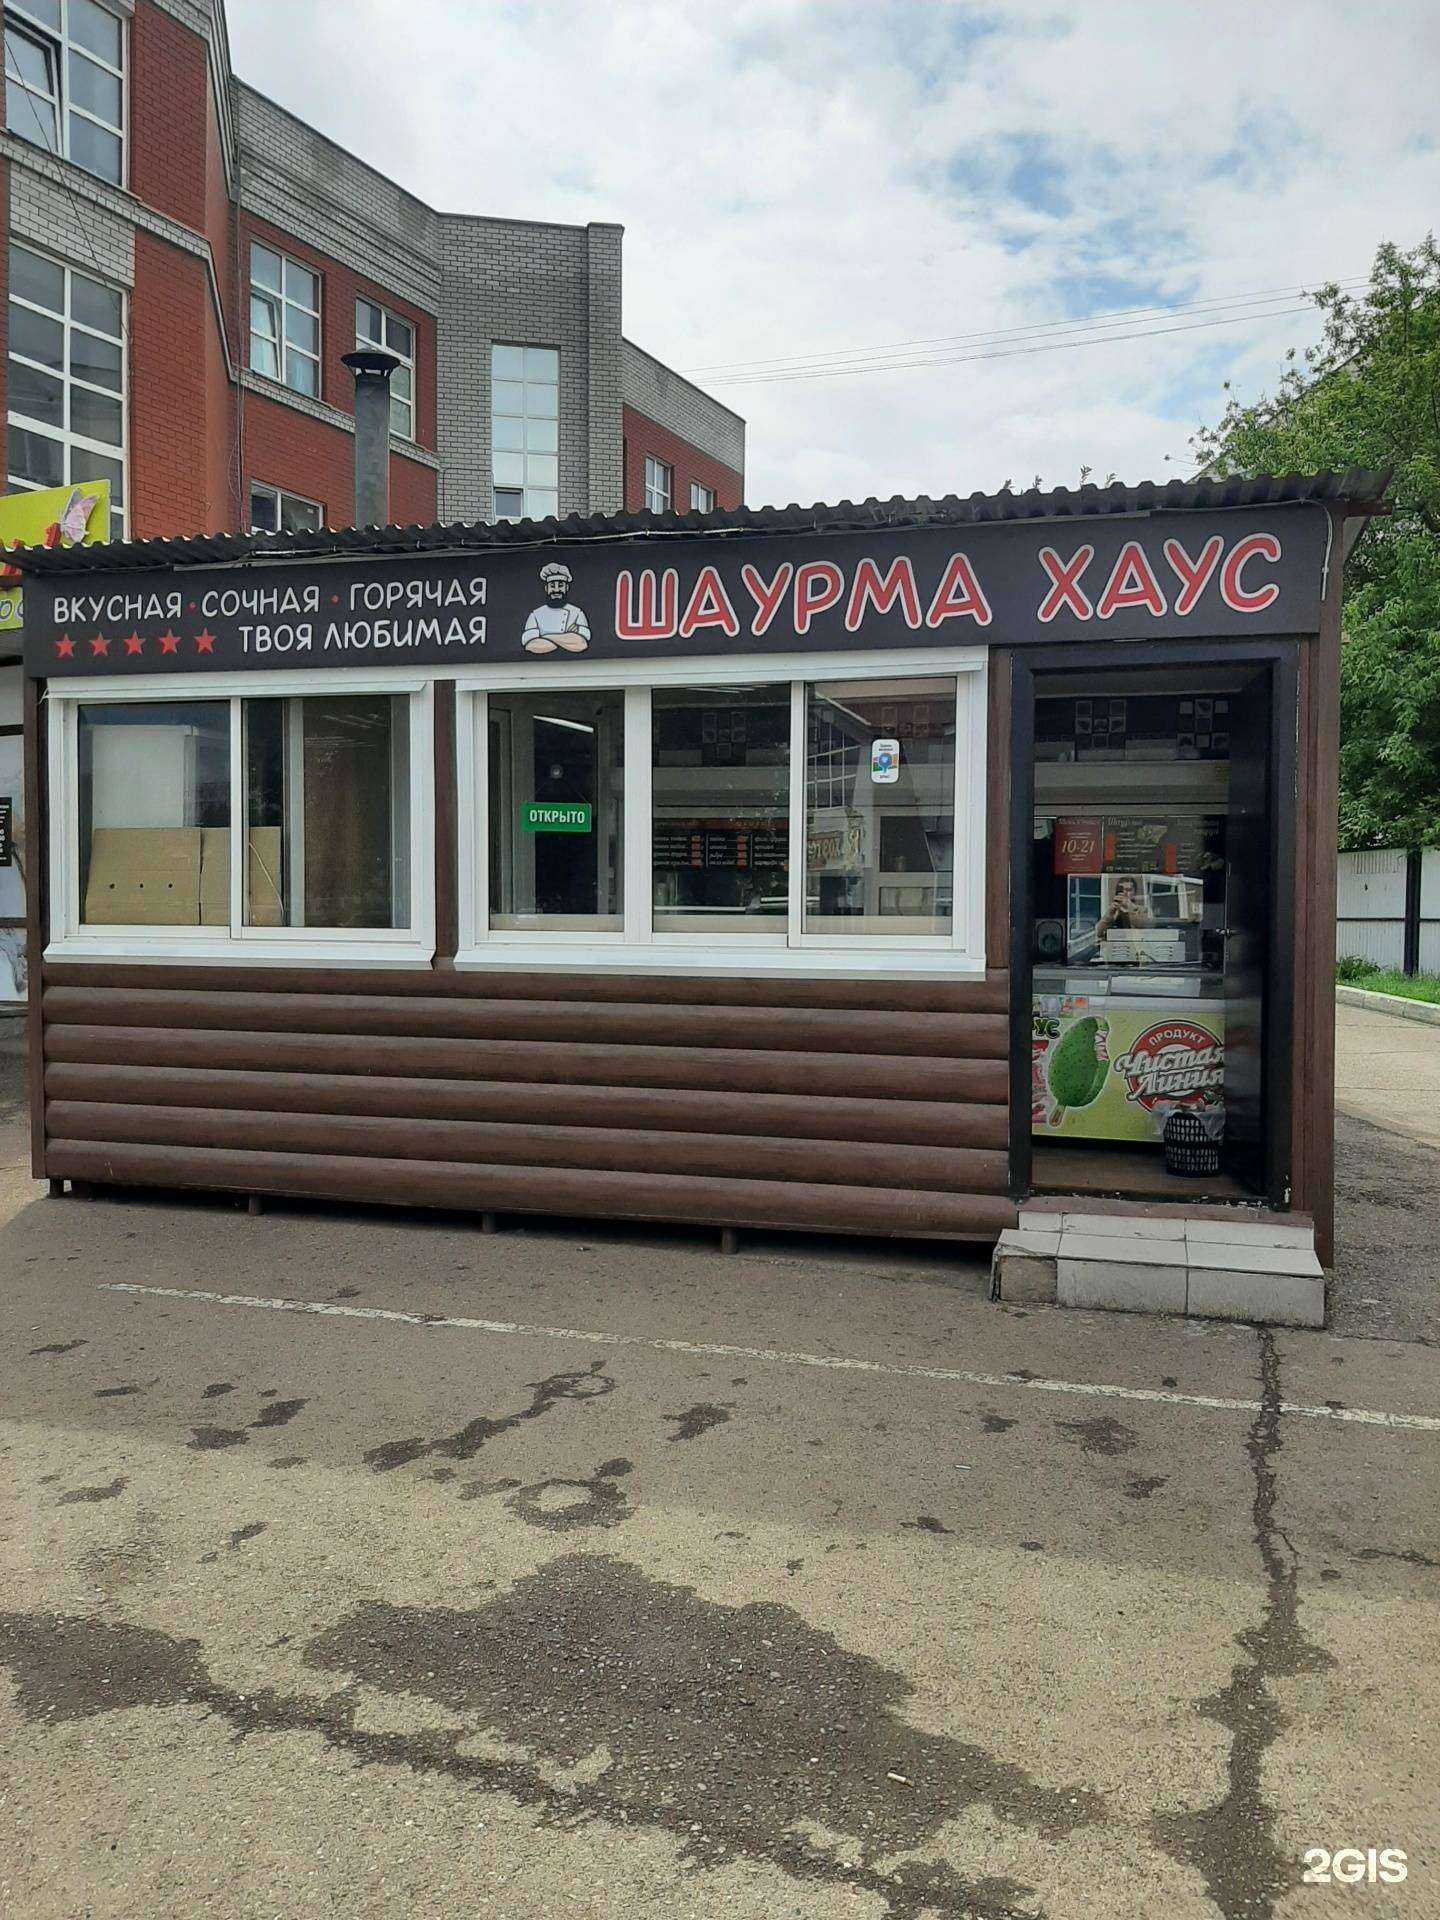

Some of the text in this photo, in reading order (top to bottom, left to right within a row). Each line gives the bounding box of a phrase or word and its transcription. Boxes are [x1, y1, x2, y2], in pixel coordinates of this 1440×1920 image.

[53, 592, 183, 624] ВКУСНАЯ
[201, 585, 321, 618] СОЧНАЯ
[348, 577, 488, 610] ГОРЯЧАЯ
[615, 532, 1283, 641] ШАУРМА ХАУС
[239, 616, 488, 653] ТВОЯ ЛЮБИМАЯ
[529, 809, 586, 824] ОТКРЫТО
[1148, 1028, 1207, 1047] ПРОДУКТ
[1126, 1067, 1225, 1102] Линия
